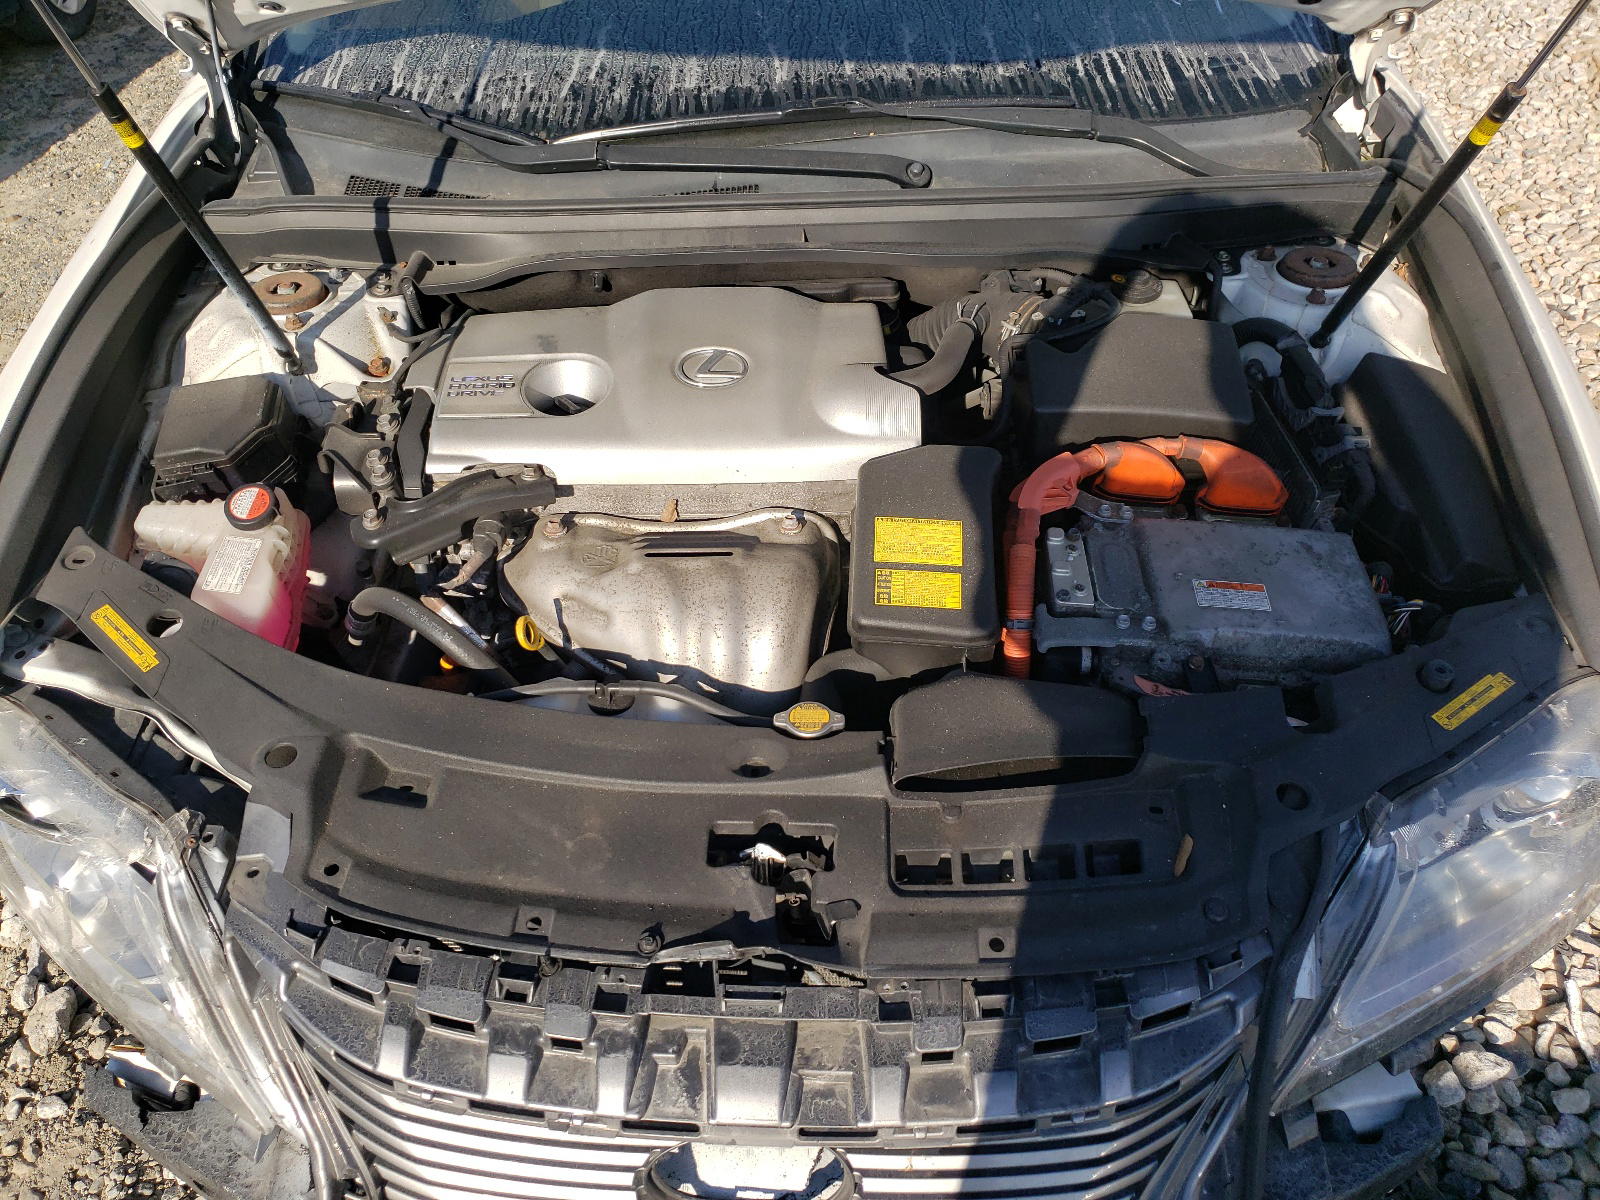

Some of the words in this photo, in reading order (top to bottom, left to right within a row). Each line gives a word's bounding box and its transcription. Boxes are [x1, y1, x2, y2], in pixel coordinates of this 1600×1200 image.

[450, 374, 514, 382] LEXUS
[448, 381, 516, 389] HYBRID
[446, 389, 505, 397] DRIVE
